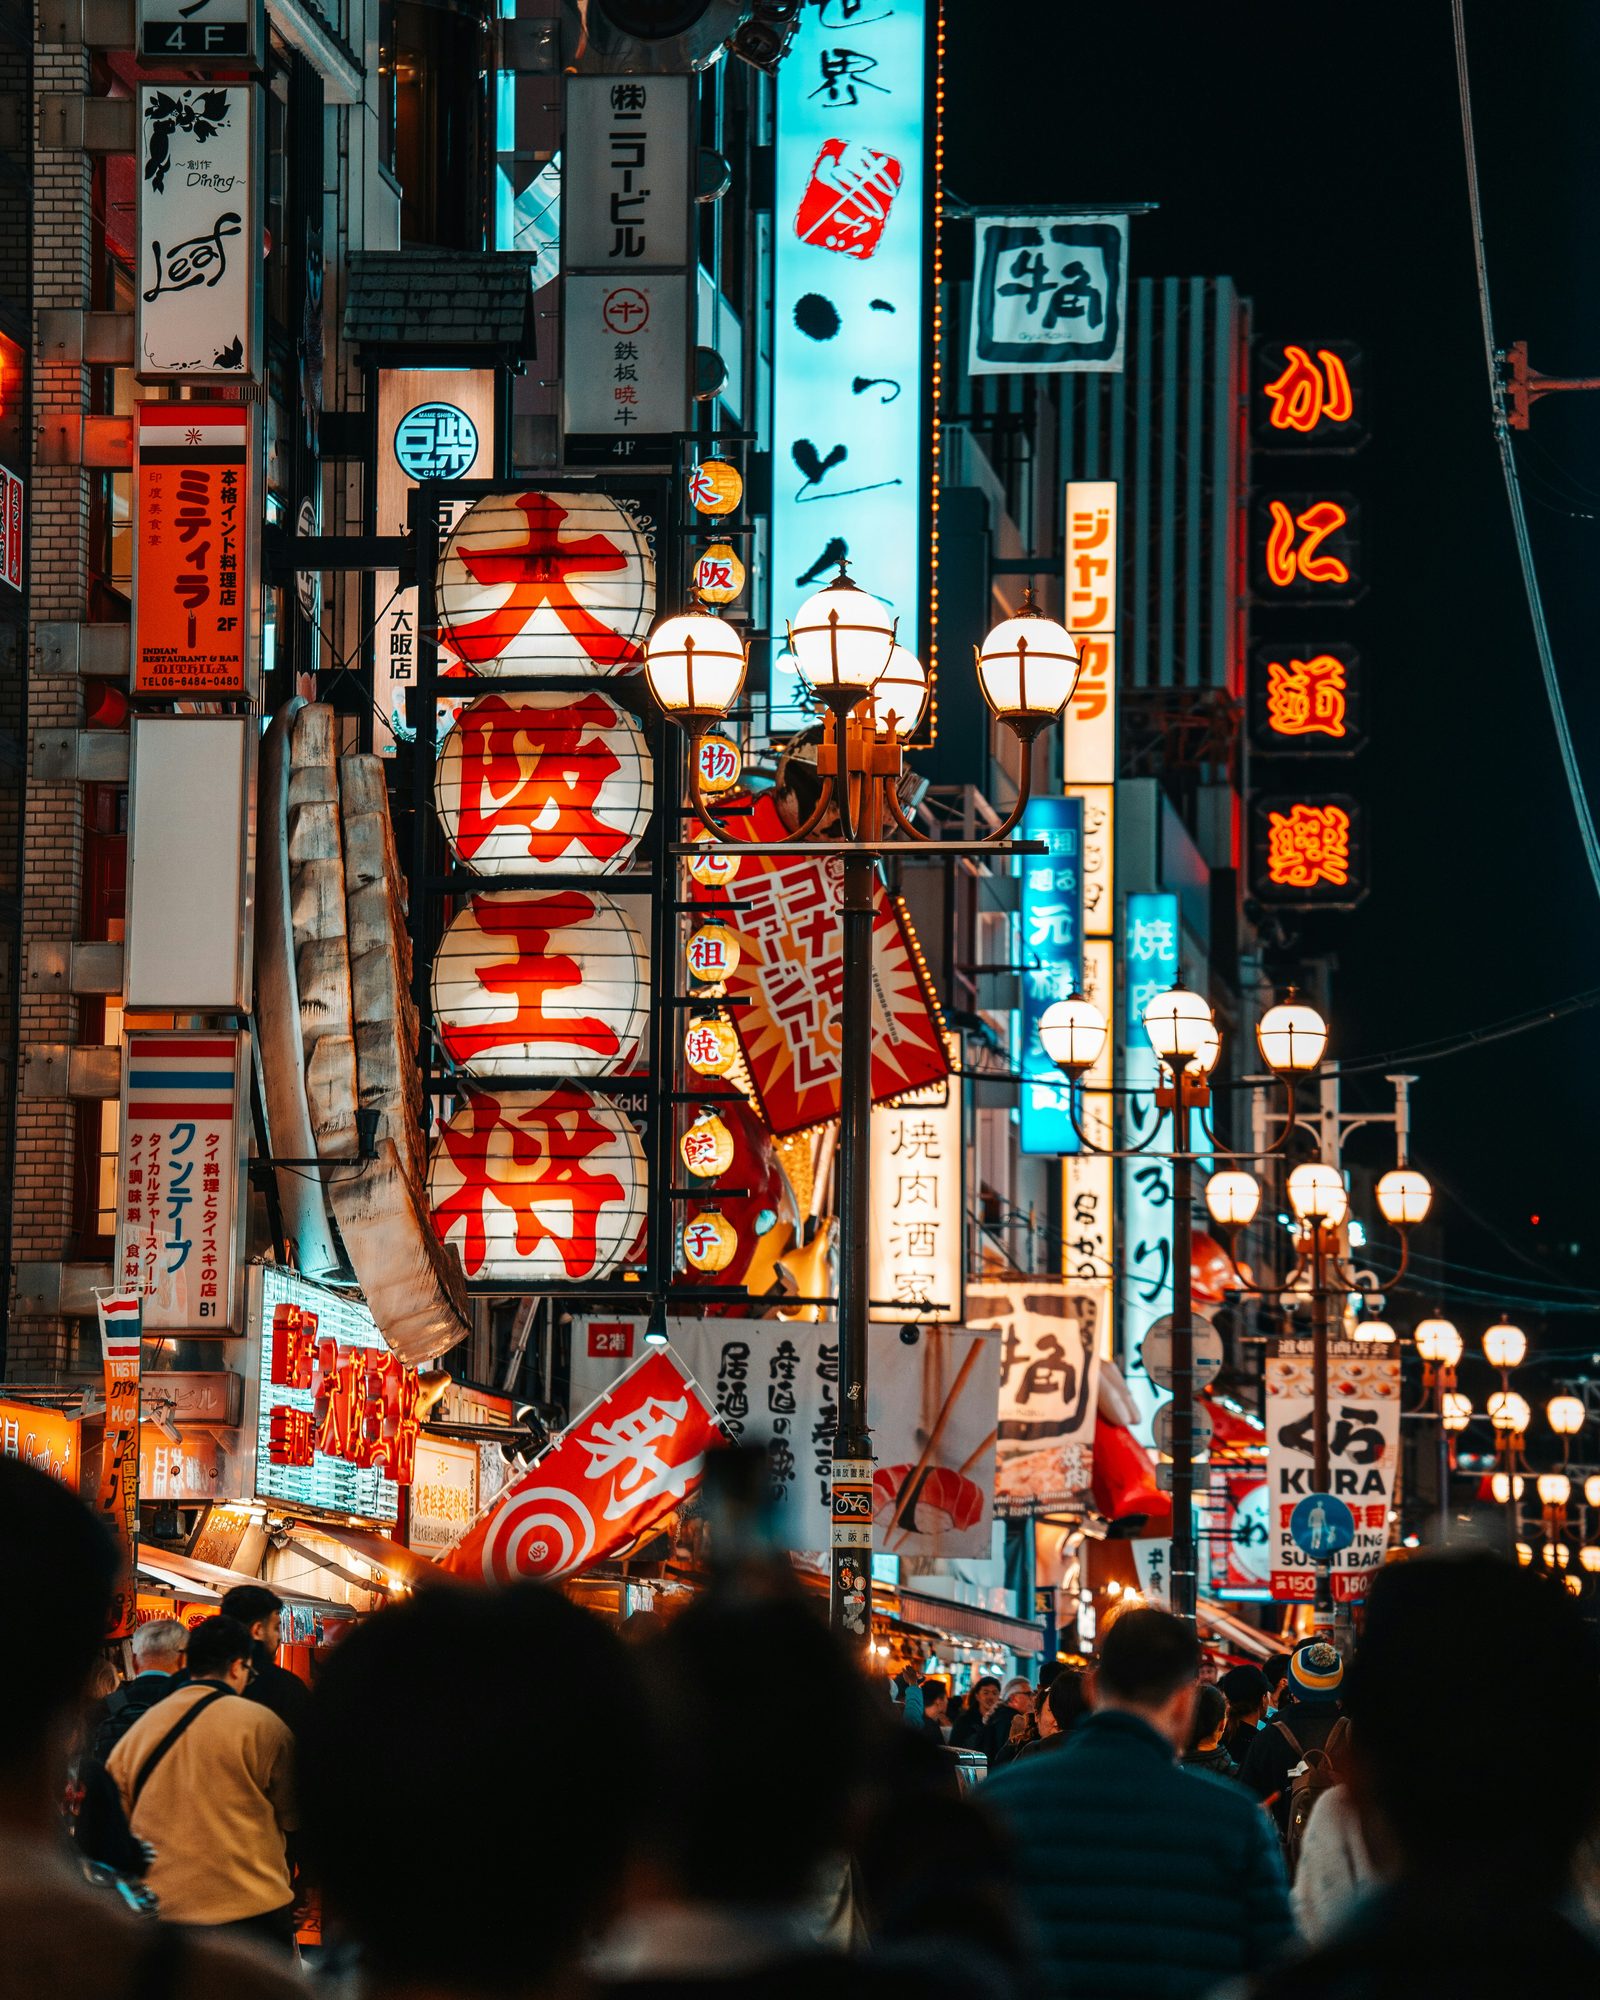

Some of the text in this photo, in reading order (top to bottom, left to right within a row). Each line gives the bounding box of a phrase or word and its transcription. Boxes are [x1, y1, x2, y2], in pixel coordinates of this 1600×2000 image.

[143, 212, 242, 303] Leaf
[997, 250, 1103, 329] 牛角
[612, 441, 636, 455] 4F
[174, 469, 212, 649] ミティラー
[219, 469, 238, 607] 本格インド料理店
[217, 617, 238, 632] 2F
[389, 609, 413, 680] 大阪店
[1072, 508, 1110, 722] ジャンカラ
[142, 655, 208, 663] RESTAURANT
[152, 664, 230, 675] MITHILA
[688, 467, 736, 1260] 大阪物元祖焼餃子
[127, 1133, 143, 1223] タイ調味料
[143, 1133, 161, 1296] タイカルチャースクール
[165, 1122, 196, 1274] クンテープ
[199, 1133, 220, 1298] タイ料理とタイスキの店
[889, 1120, 941, 1304] 焼肉酒家
[199, 1302, 217, 1317] B1
[595, 1333, 625, 1351] 2階
[1280, 1468, 1386, 1496] KURA
[834, 1532, 871, 1543] 大阪市
[1347, 1550, 1380, 1567] BAR
